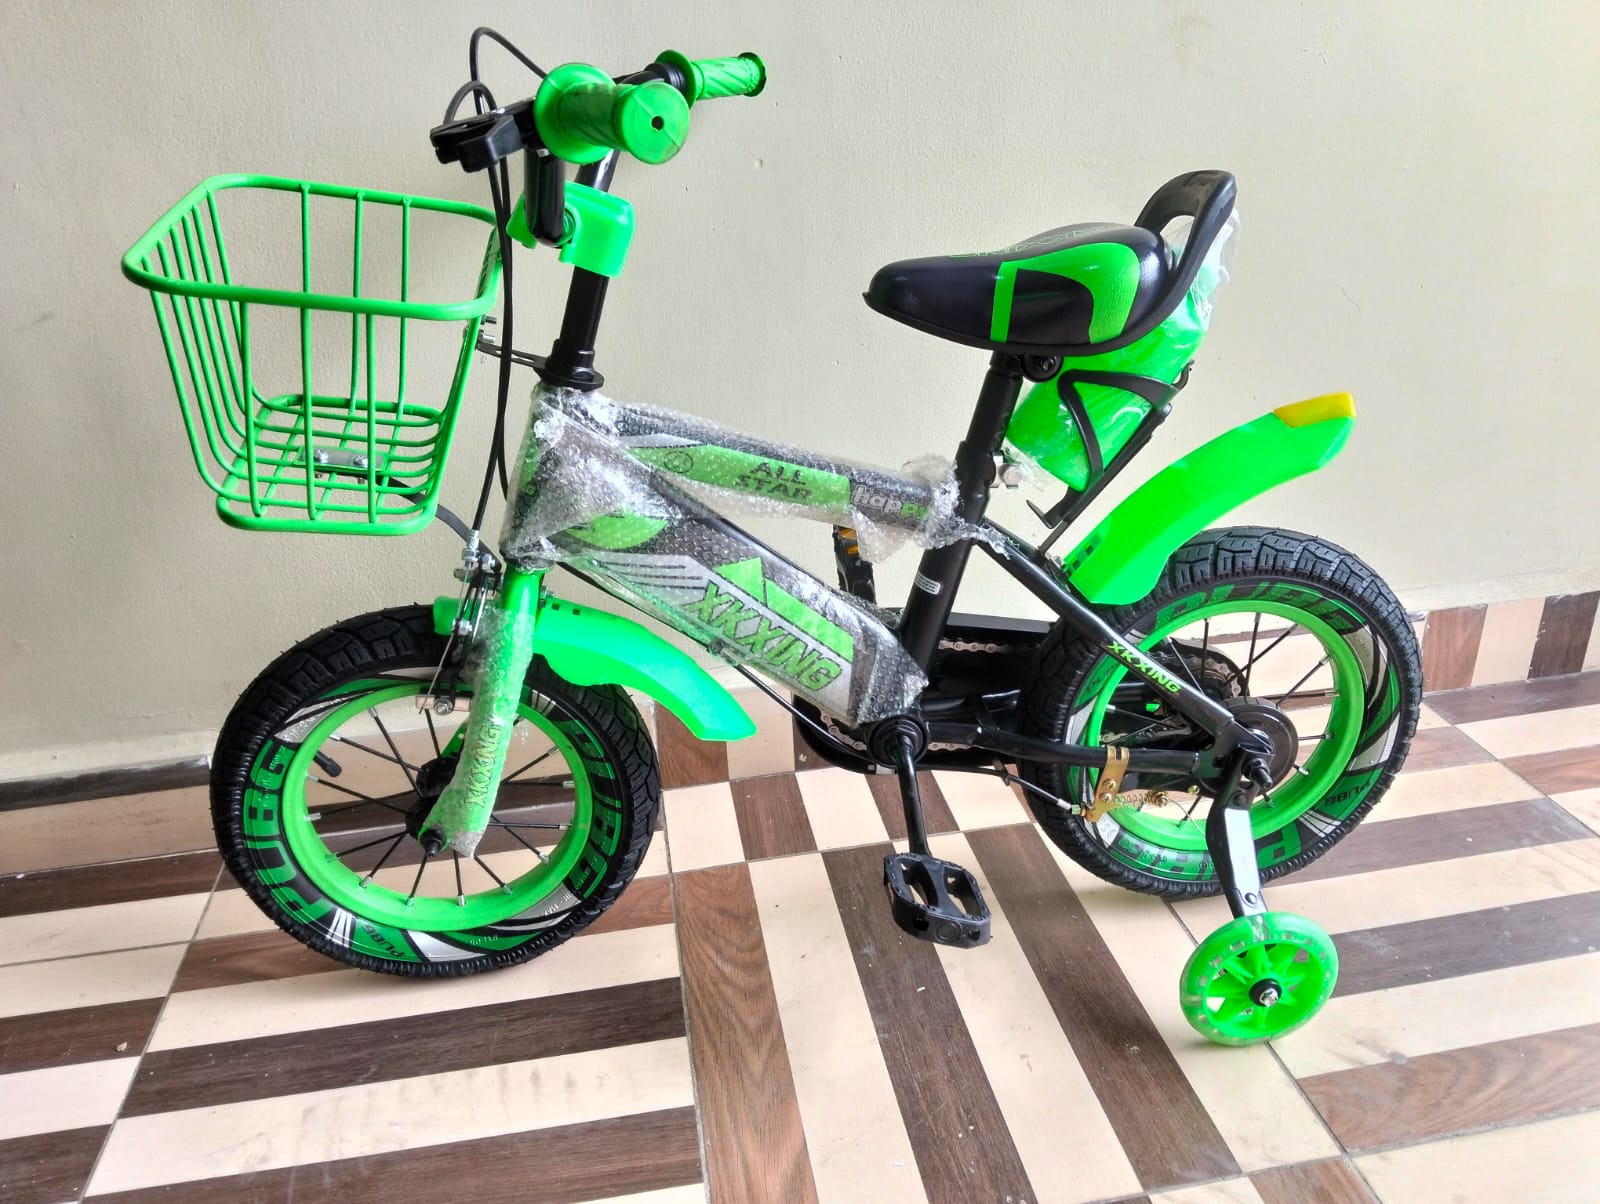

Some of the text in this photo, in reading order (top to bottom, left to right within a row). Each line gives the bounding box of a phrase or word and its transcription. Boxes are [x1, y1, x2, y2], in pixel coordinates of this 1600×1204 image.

[734, 475, 812, 499] STAR
[749, 461, 806, 485] ALL
[685, 579, 842, 691] XKXING
[1106, 640, 1181, 693] XKXING
[243, 738, 335, 925] PUBG
[363, 920, 406, 957] PUBG
